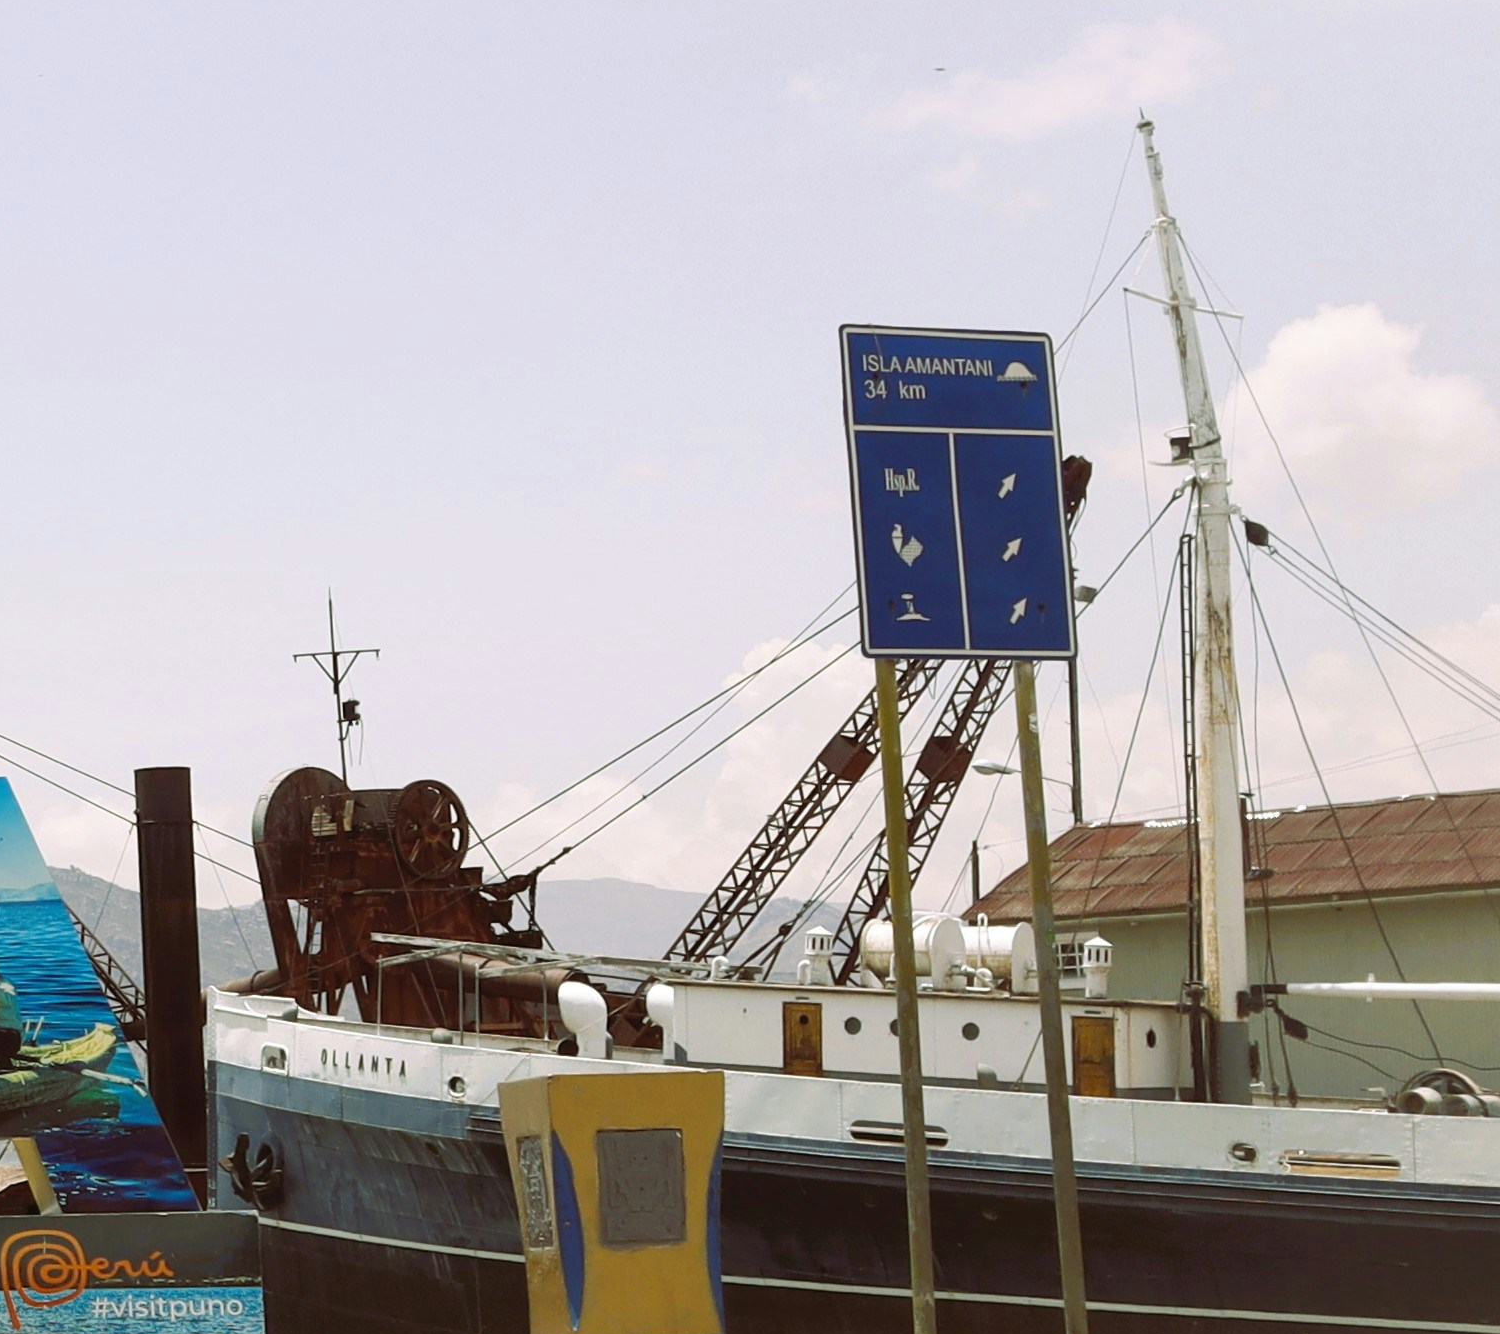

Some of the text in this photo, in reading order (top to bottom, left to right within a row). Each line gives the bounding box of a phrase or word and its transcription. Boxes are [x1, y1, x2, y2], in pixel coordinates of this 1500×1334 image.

[861, 354, 994, 377] ISLA AMANTANI
[864, 379, 926, 400] 34 km
[320, 1048, 407, 1078] OLLANTA
[0, 1229, 176, 1330] Perú
[92, 1294, 244, 1323] #visitpuno
